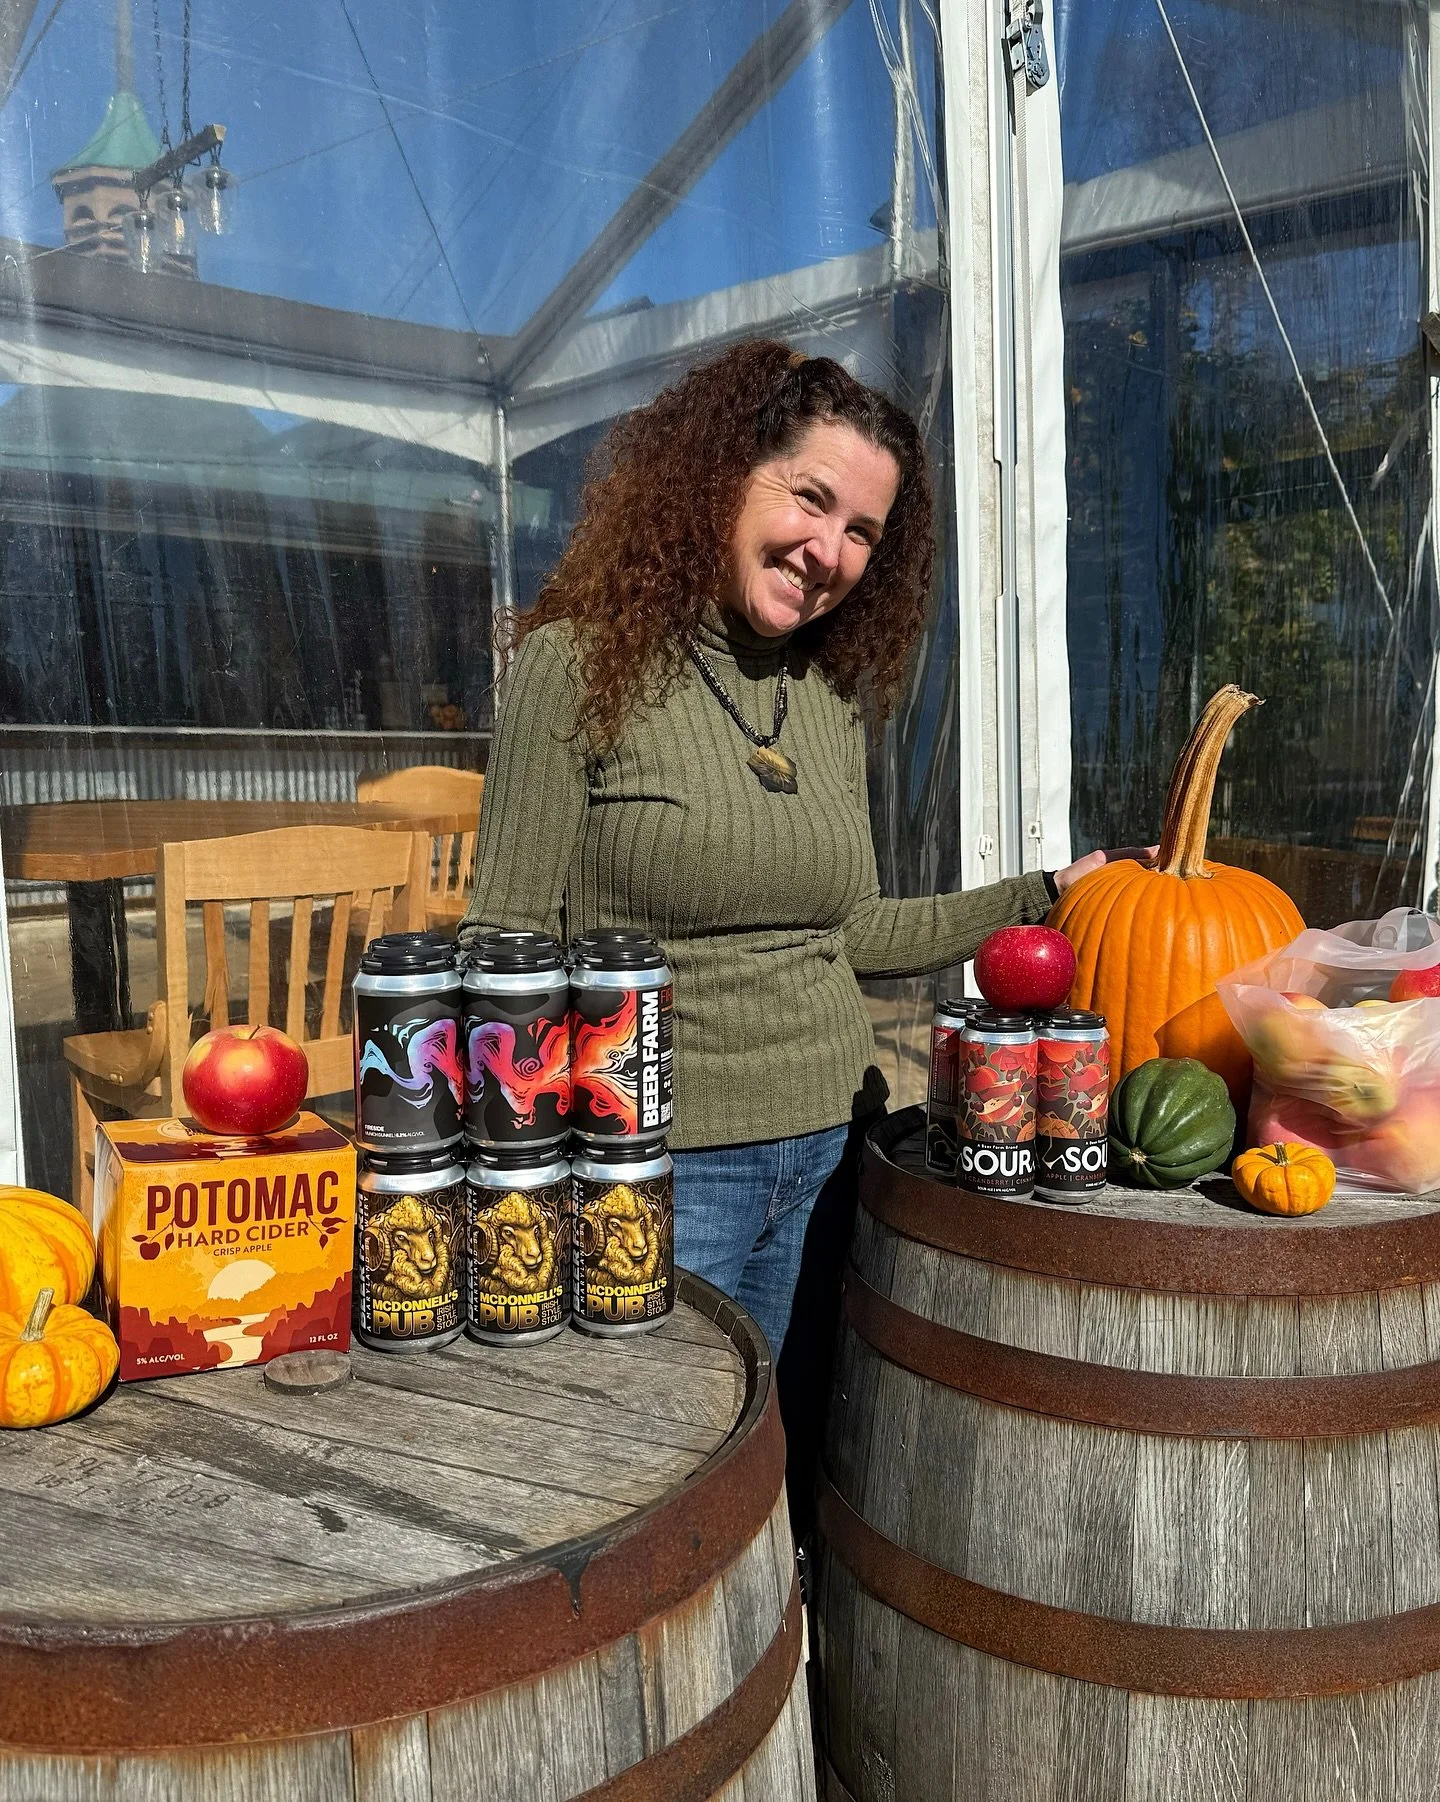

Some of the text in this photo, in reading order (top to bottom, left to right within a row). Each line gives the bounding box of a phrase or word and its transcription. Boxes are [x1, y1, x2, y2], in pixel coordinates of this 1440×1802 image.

[642, 990, 659, 1128] BEER FARM
[962, 1146, 1033, 1177] SOUR
[1065, 1142, 1108, 1173] SOU
[968, 1175, 1009, 1186] CRANBERRY
[1046, 1173, 1067, 1181] APPLE
[146, 1170, 339, 1231] POTOMAC
[177, 1221, 309, 1249] HARD CIDER
[213, 1243, 272, 1257] CRISP APPLE
[586, 1277, 667, 1297] MCDONNELL'S
[372, 1289, 459, 1312] MCDONNELL'S
[479, 1285, 563, 1306] MCDONNELL'S
[647, 1291, 663, 1302] IRISH
[647, 1296, 666, 1309] STYLE
[436, 1304, 455, 1316] IRISH
[541, 1300, 559, 1311] IRISH
[541, 1306, 561, 1318] STYLE
[586, 1294, 646, 1321] PUB
[647, 1302, 667, 1317] STOUT
[373, 1310, 436, 1337] PUB
[436, 1310, 457, 1323] STYLE
[436, 1316, 458, 1331] STOUT
[480, 1303, 540, 1331] PUB
[541, 1312, 562, 1326] STOUT
[327, 1333, 338, 1341] OZ
[136, 1353, 185, 1365] 5% ALC/VOL
